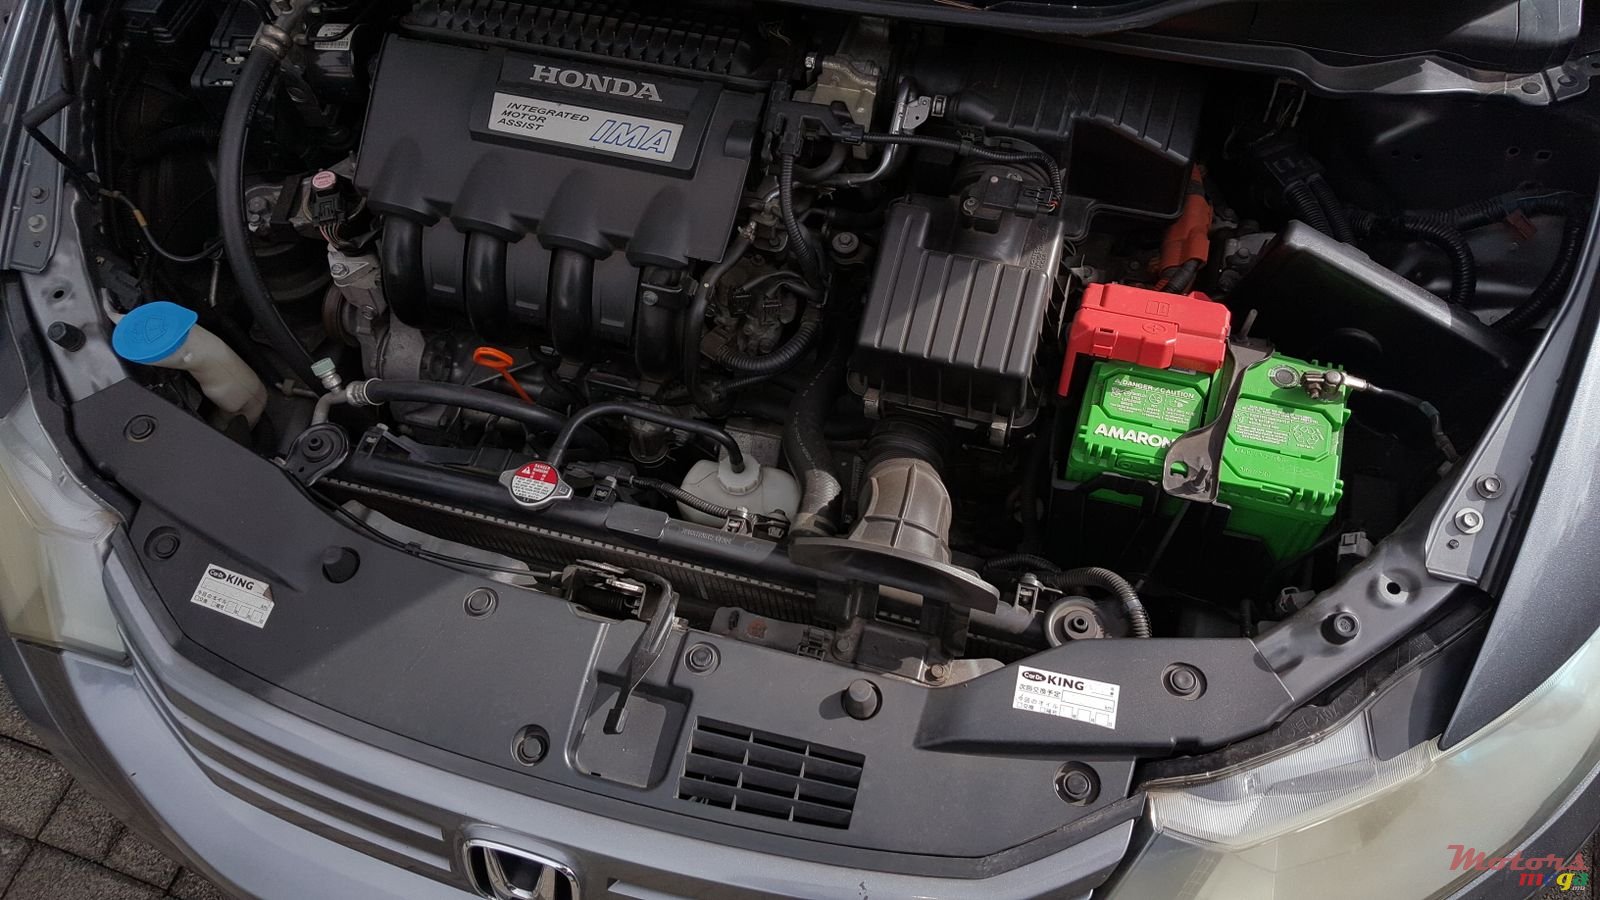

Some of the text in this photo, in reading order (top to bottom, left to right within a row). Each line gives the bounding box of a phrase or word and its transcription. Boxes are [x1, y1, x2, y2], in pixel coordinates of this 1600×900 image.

[529, 64, 663, 102] HONDA
[501, 110, 547, 124] MOTOR
[506, 102, 590, 122] INTEGRATED
[497, 118, 544, 131] ASSIST
[589, 119, 672, 154] IMA
[1122, 379, 1153, 391] DANGER
[1160, 387, 1195, 399] CAUTION
[226, 574, 255, 591] KING
[1047, 675, 1085, 691] KING
